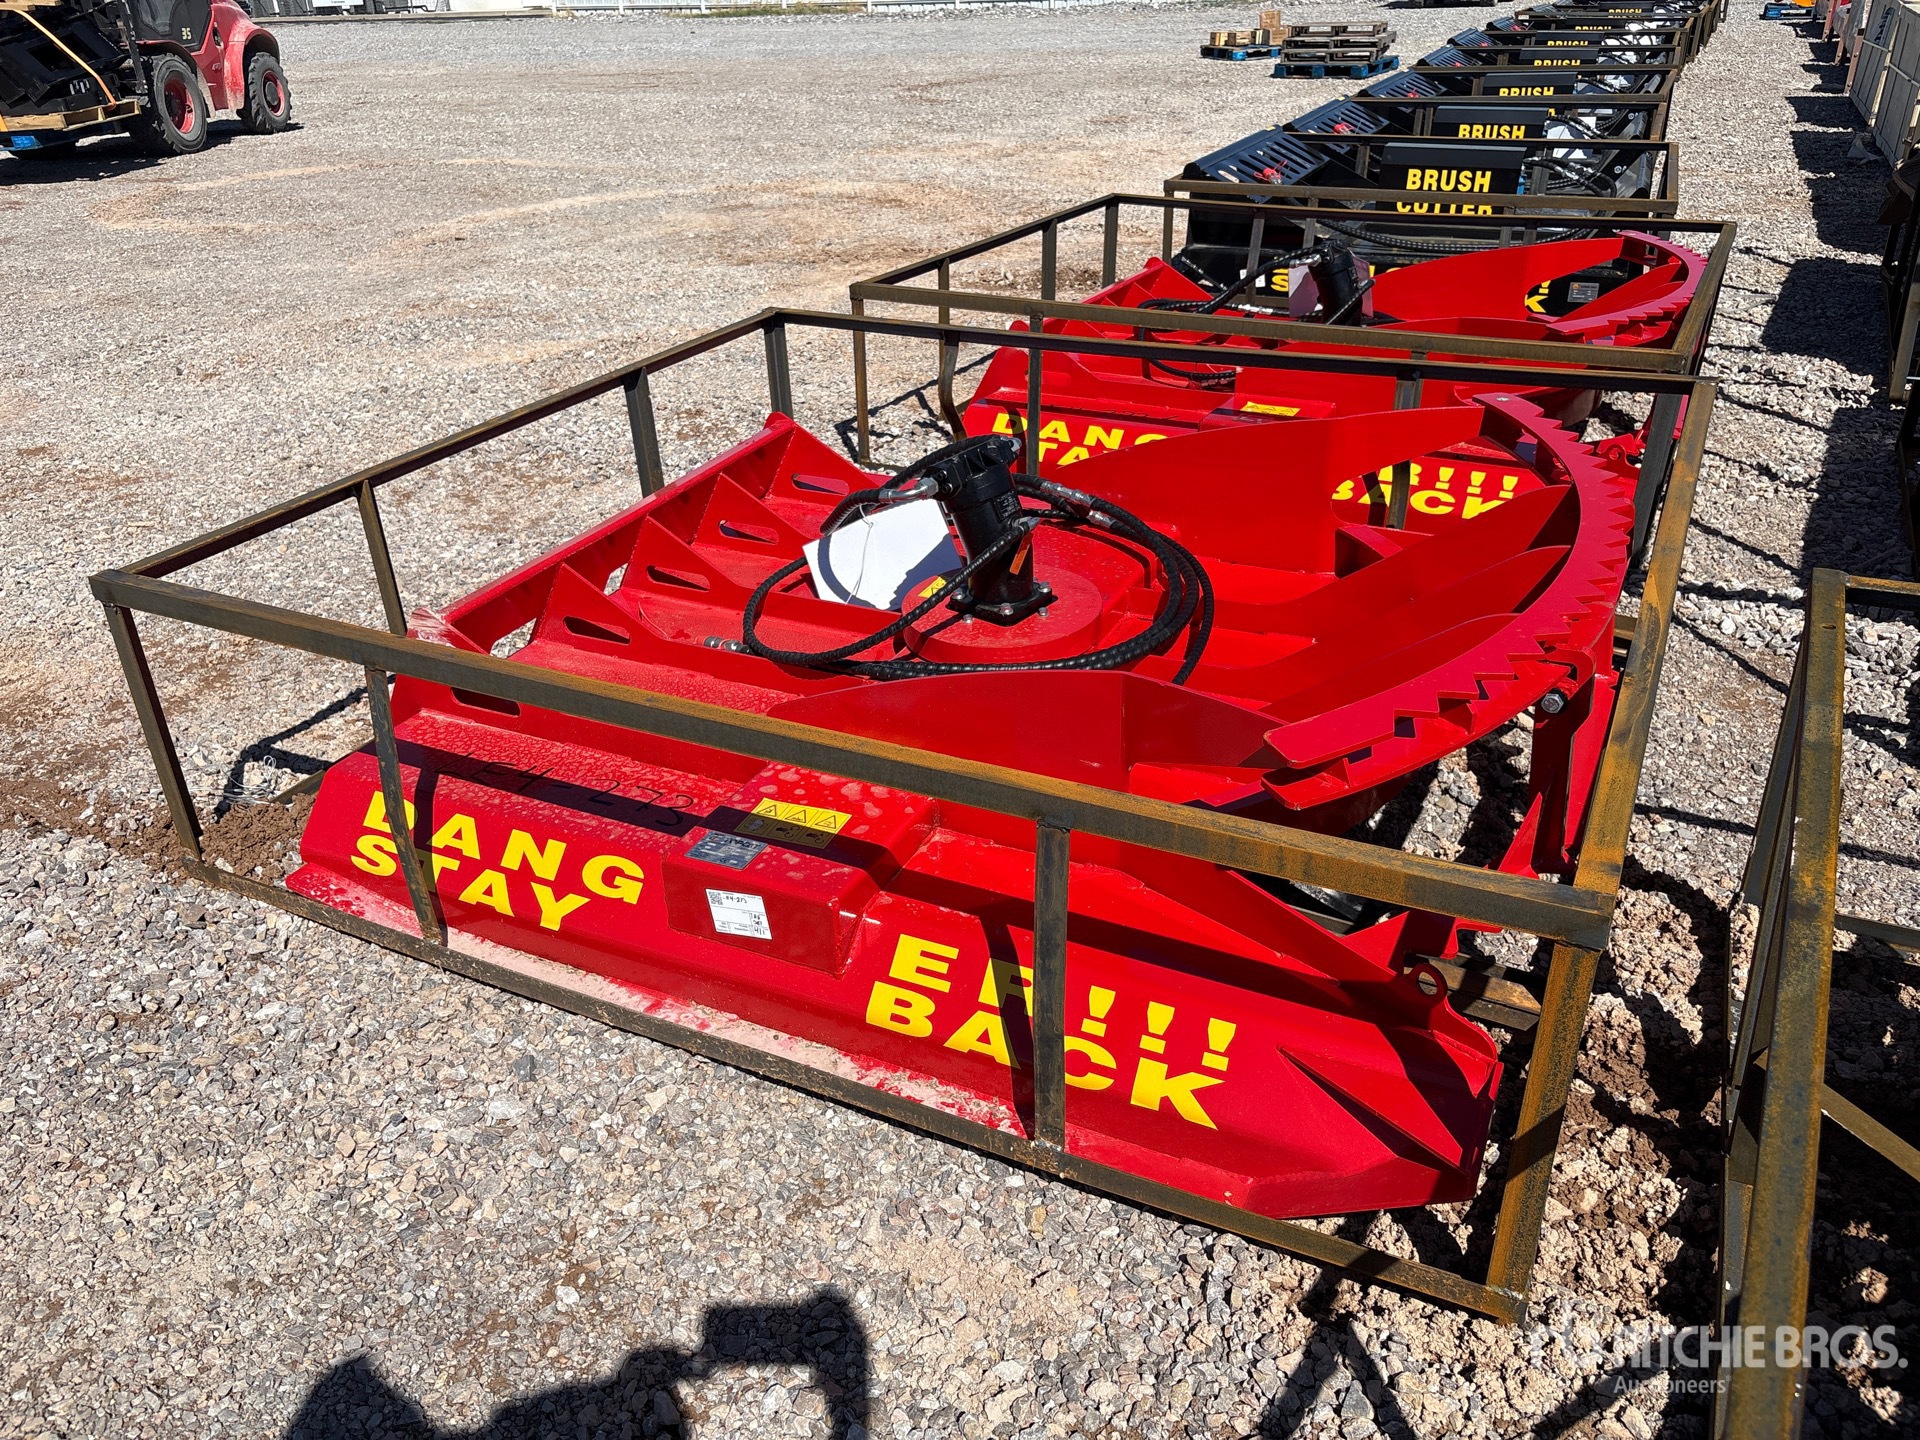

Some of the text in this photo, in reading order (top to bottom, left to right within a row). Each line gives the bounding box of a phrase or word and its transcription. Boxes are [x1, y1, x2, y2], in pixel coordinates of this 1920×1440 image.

[181, 27, 192, 40] 35
[1499, 87, 1554, 96] BRUSH
[1458, 124, 1525, 139] BRUSH
[1406, 168, 1492, 193] BRUSH
[351, 834, 1226, 1131] STAY BACK
